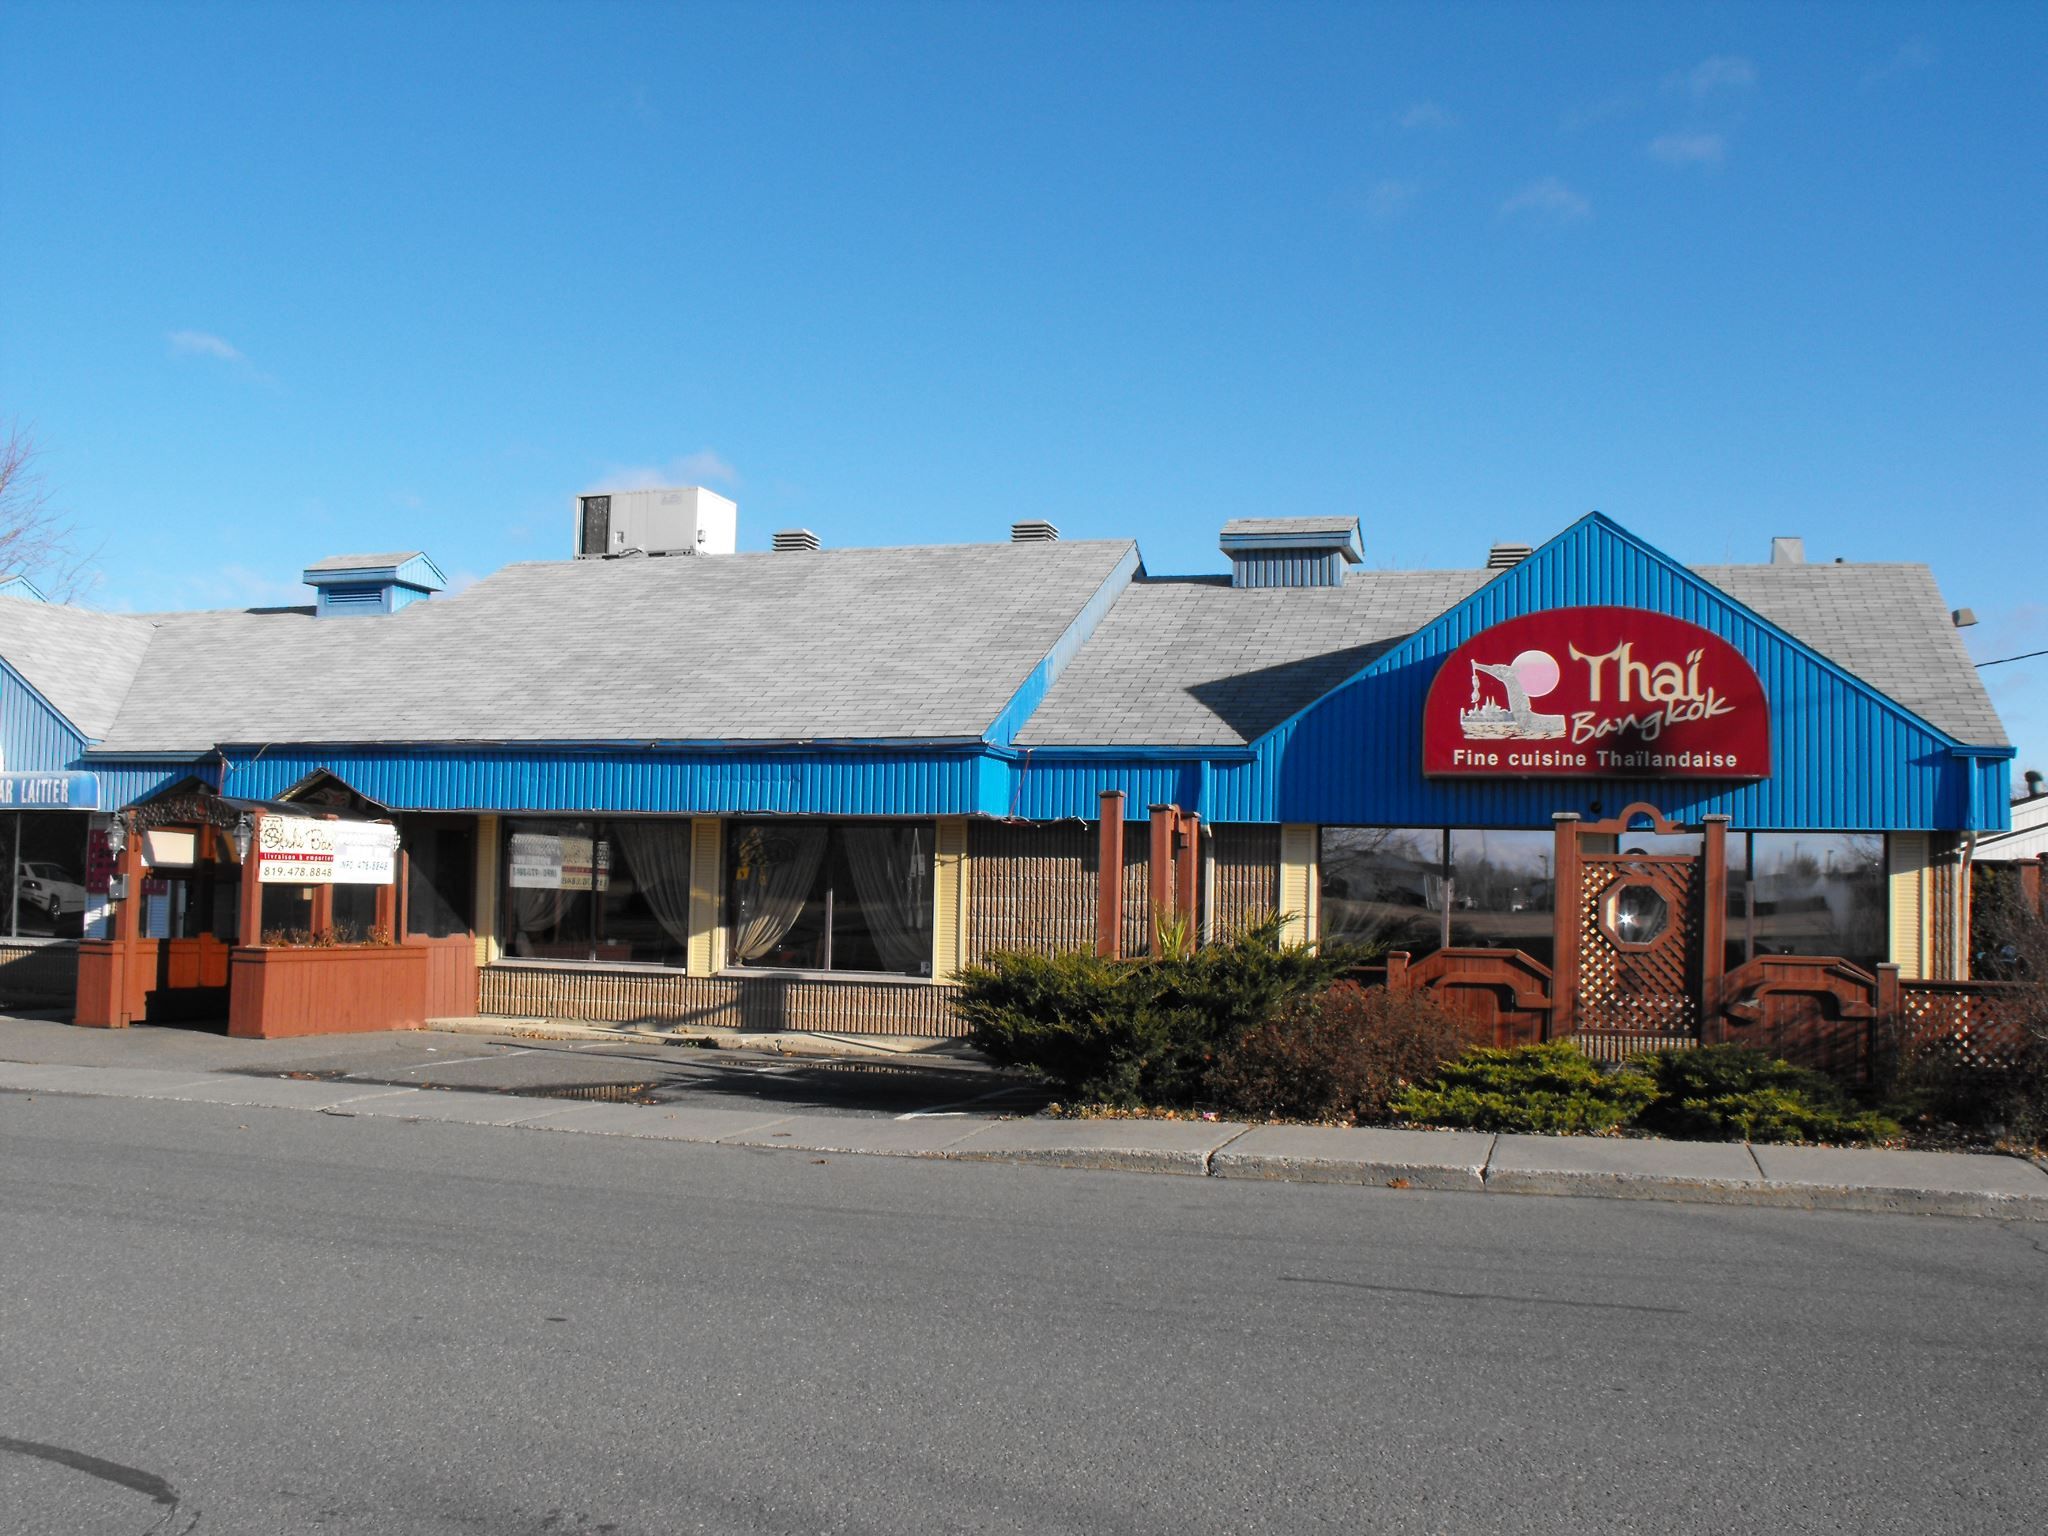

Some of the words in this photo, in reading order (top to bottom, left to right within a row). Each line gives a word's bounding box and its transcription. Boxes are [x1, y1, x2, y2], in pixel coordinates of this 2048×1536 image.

[1568, 637, 1705, 702] Thaï
[1571, 687, 1736, 744] Bangkok
[1453, 749, 1499, 766] Fine
[1508, 749, 1587, 767] cuisine
[1599, 750, 1738, 768] Thaïlandaise
[0, 779, 14, 803] AR
[21, 778, 69, 803] LAITIER
[263, 853, 296, 861] livraison
[263, 866, 333, 877] 819.478.8848
